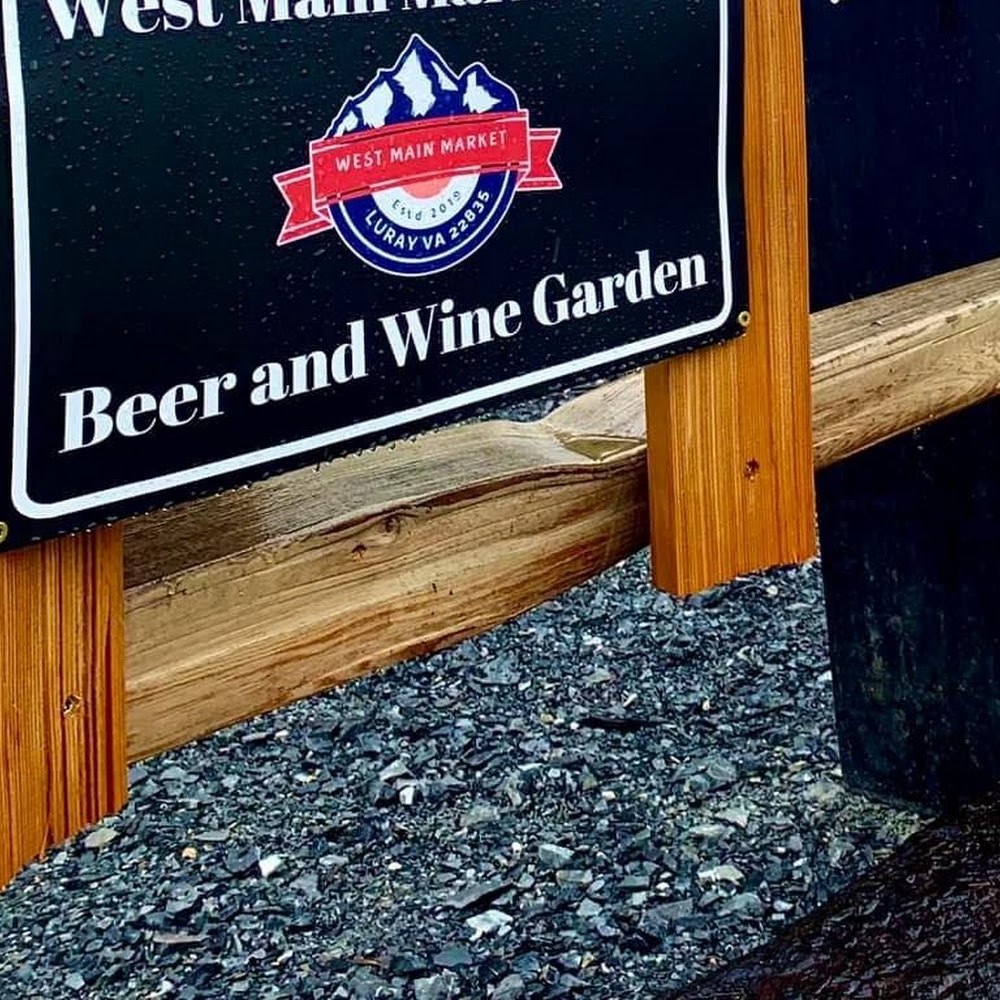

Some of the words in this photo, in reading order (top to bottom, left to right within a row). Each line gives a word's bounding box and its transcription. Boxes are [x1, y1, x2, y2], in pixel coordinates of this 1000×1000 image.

[335, 149, 383, 172] WEST
[390, 141, 435, 163] MAIN
[440, 129, 508, 153] MARKET
[365, 209, 418, 251] LURAY
[422, 232, 446, 250] VA
[448, 190, 490, 240] 22835
[431, 190, 461, 218] 2019
[58, 386, 237, 453] Beer
[250, 319, 369, 406] and
[378, 299, 522, 368] Wine
[533, 249, 708, 326] Garden
